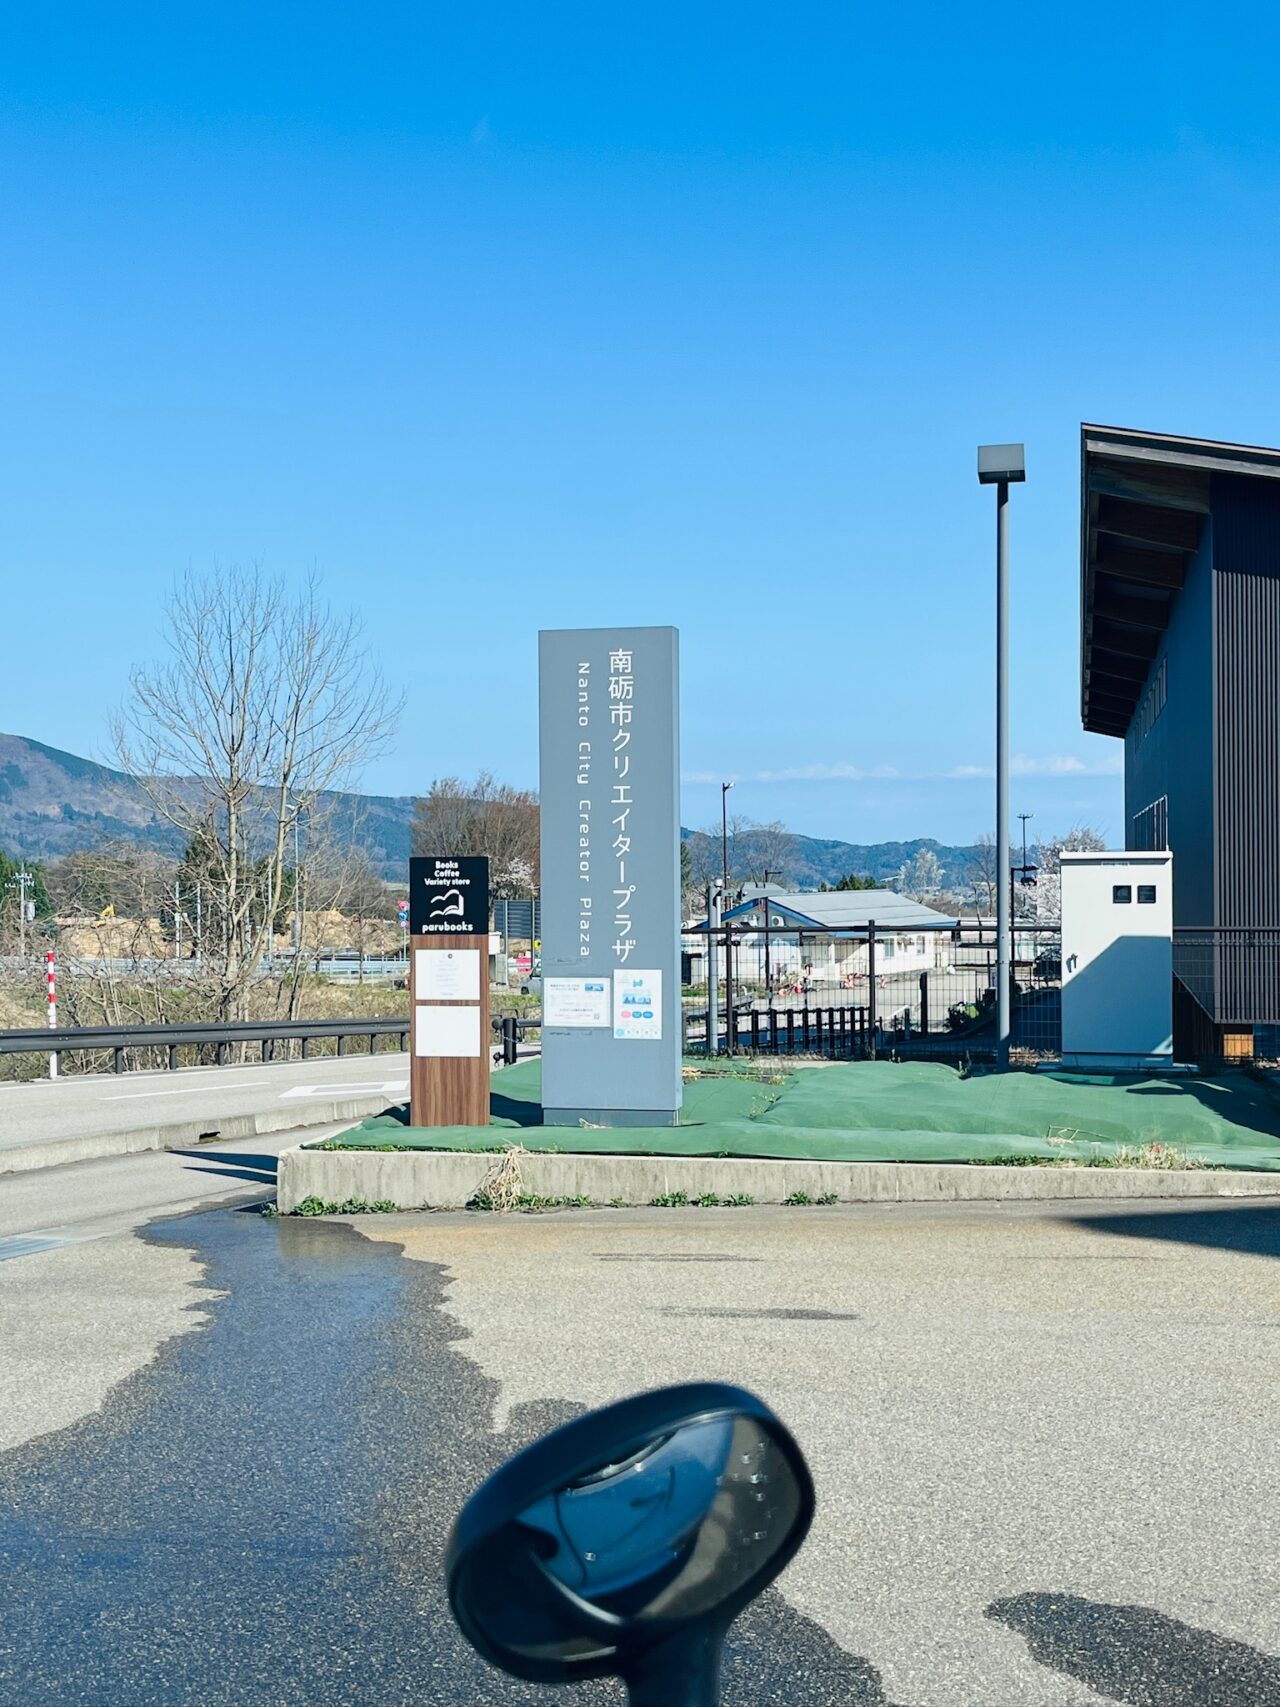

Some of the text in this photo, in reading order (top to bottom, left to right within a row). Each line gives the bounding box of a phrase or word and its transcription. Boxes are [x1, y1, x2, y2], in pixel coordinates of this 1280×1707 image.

[577, 662, 592, 956] Nanto City Creator Plaza
[608, 649, 637, 963] 南砺市クリエイタープラザ
[435, 860, 459, 869] Books
[434, 869, 460, 877] Coffee
[424, 878, 471, 886] Variety store
[422, 921, 474, 934] parubooks
